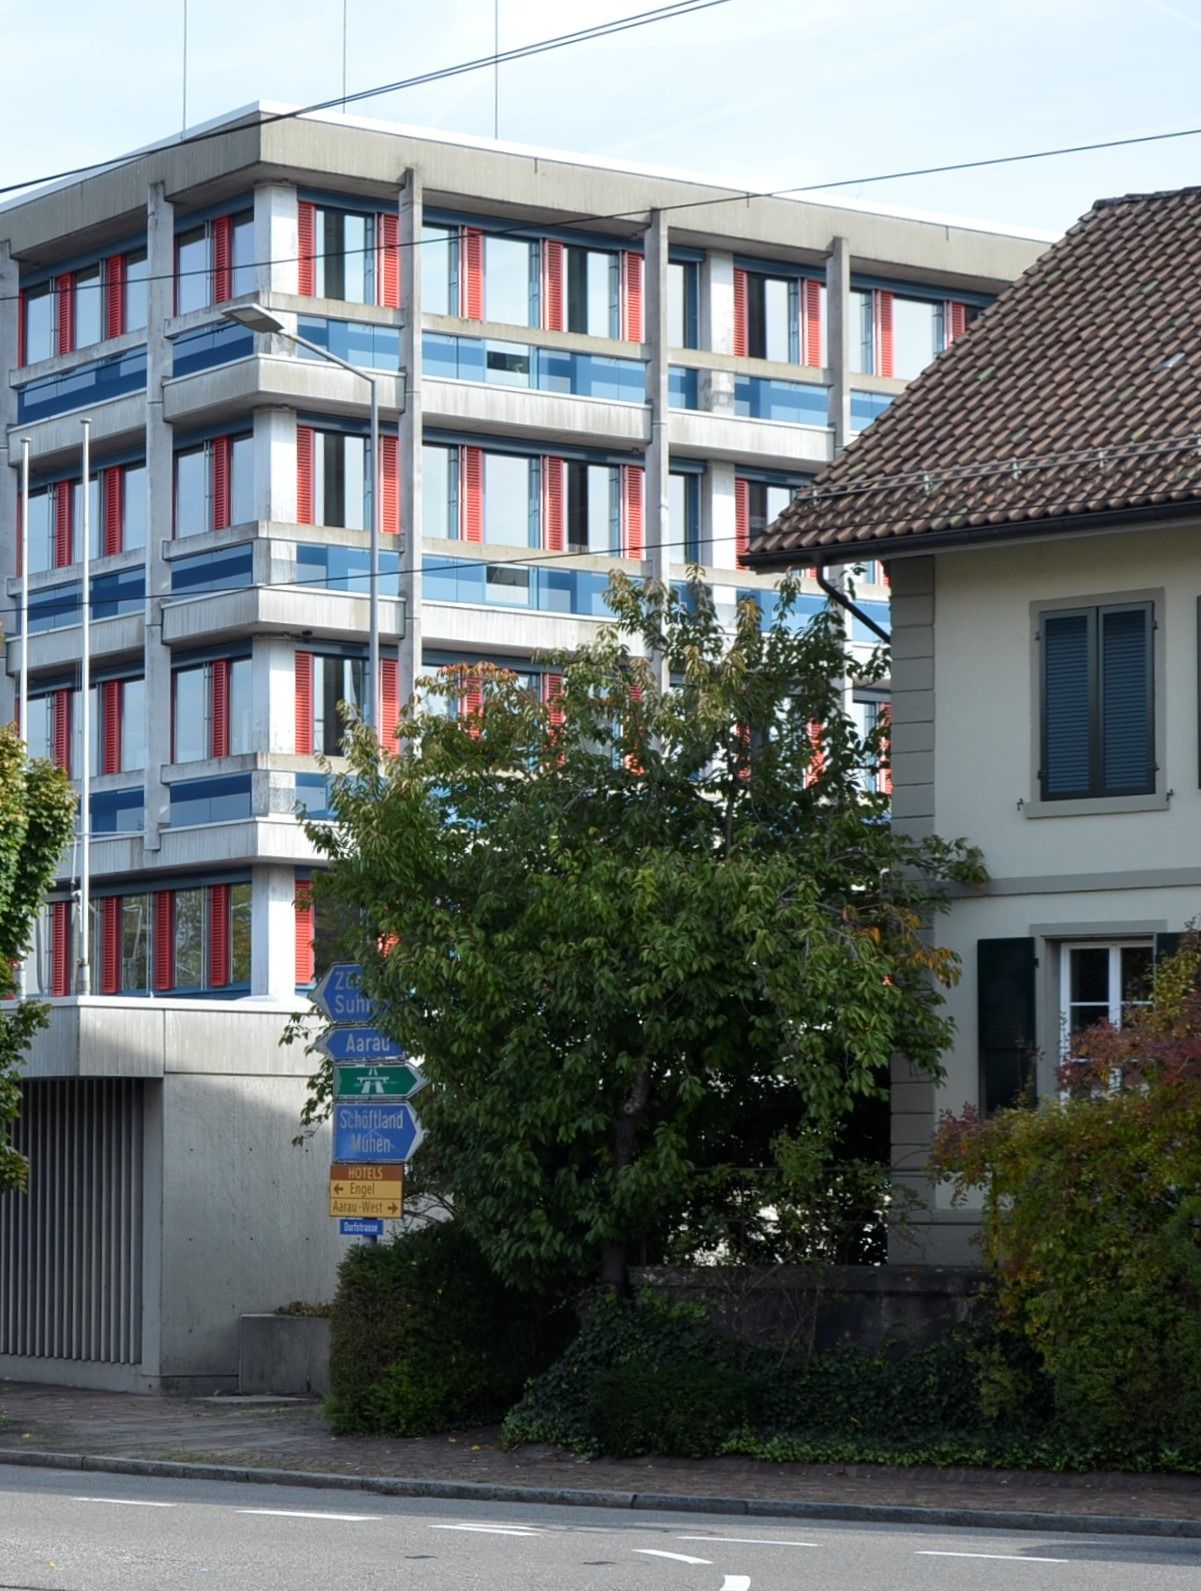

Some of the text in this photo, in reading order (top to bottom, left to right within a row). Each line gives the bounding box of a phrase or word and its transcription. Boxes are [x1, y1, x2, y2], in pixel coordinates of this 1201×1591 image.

[345, 1033, 391, 1053] Aarau
[340, 1109, 404, 1129] Schöftland
[348, 1167, 383, 1180] HOTELS
[350, 1183, 376, 1198] Engel
[343, 1221, 378, 1233] Dorfstrasse
